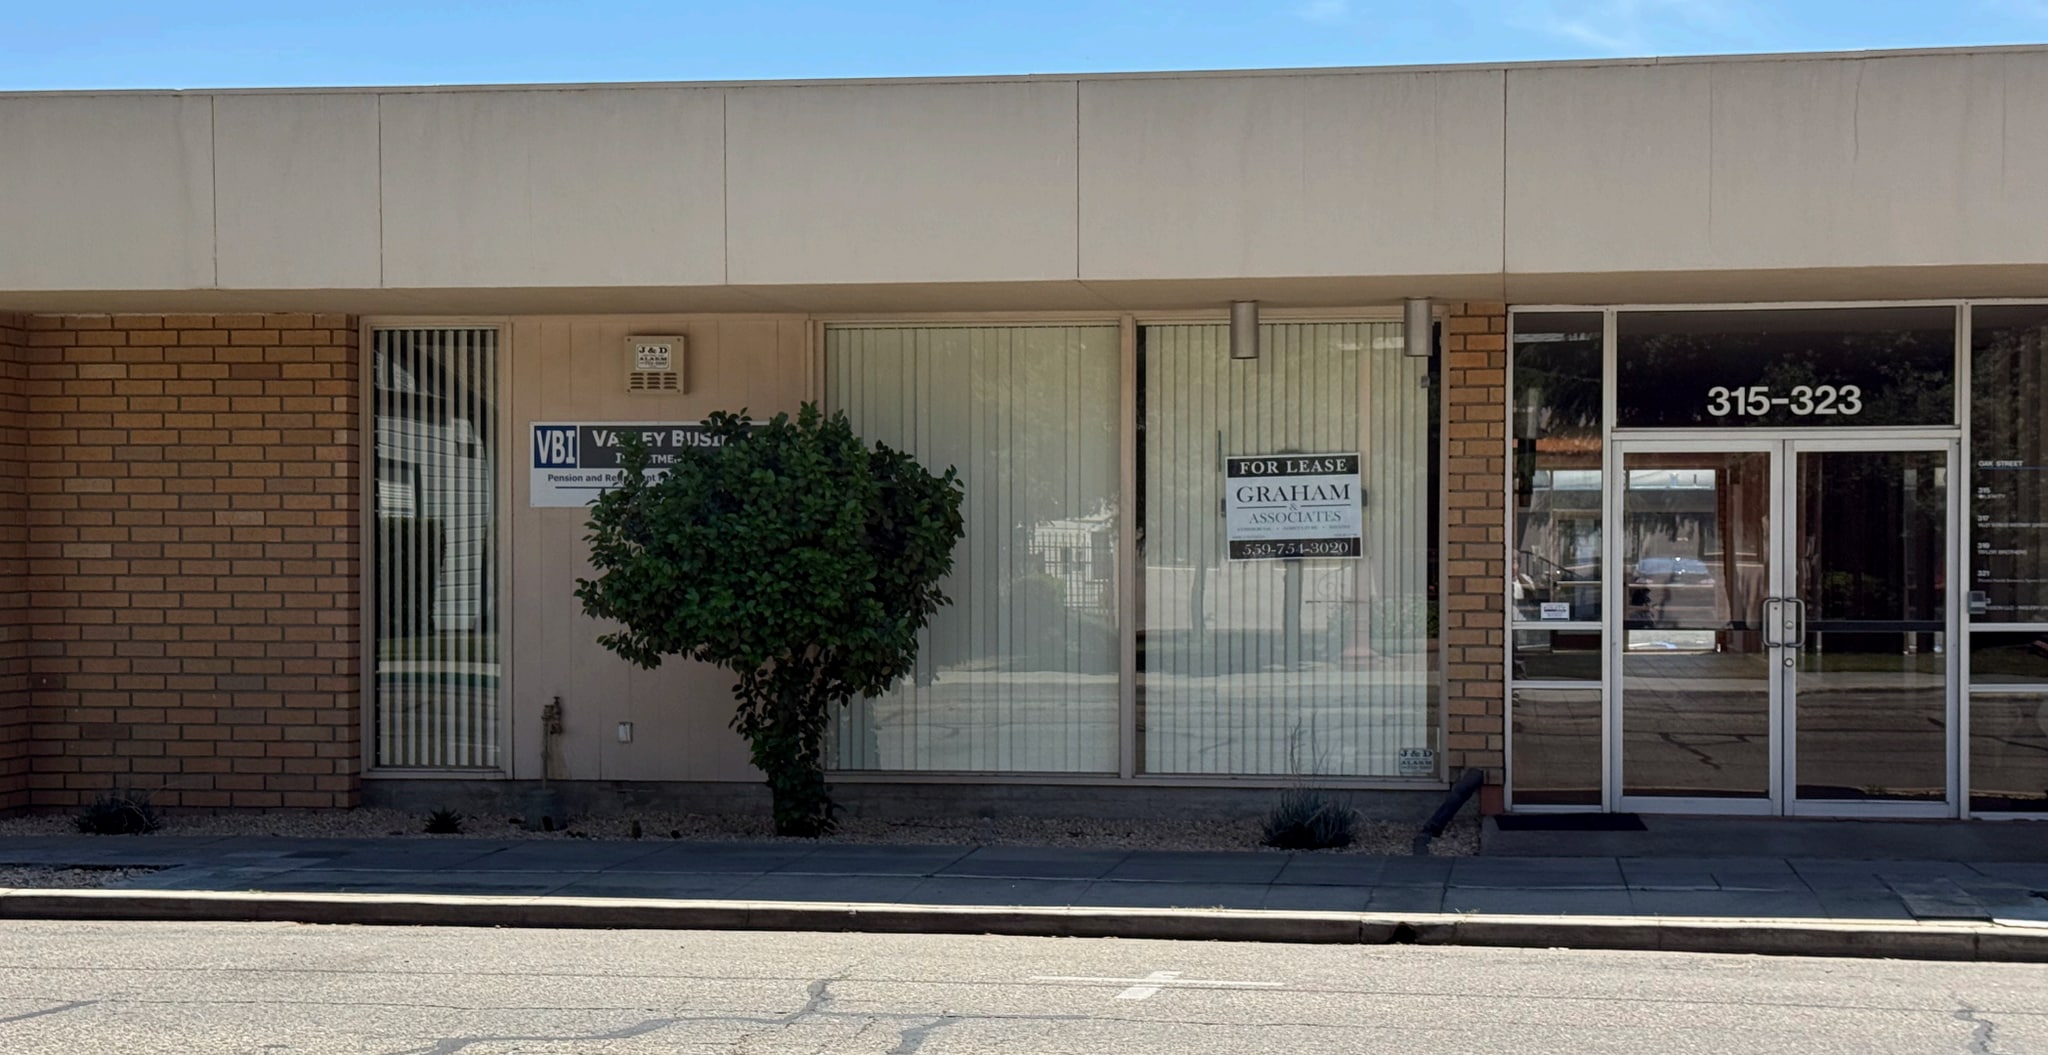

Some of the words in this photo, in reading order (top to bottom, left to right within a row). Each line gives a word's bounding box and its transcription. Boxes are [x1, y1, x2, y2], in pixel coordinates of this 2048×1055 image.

[639, 346, 646, 354] J
[647, 346, 657, 354] &
[659, 346, 668, 354] D
[1706, 384, 1863, 416] 315-323
[536, 429, 576, 465] VBI
[592, 429, 667, 448] VAEY
[1240, 460, 1280, 475] FOR
[1286, 458, 1347, 473] LEASE
[547, 473, 584, 482] Pension
[585, 473, 603, 482] and
[1236, 483, 1351, 503] GRAHAM
[1289, 502, 1298, 511] &
[1249, 510, 1342, 525] ASSOCIATES
